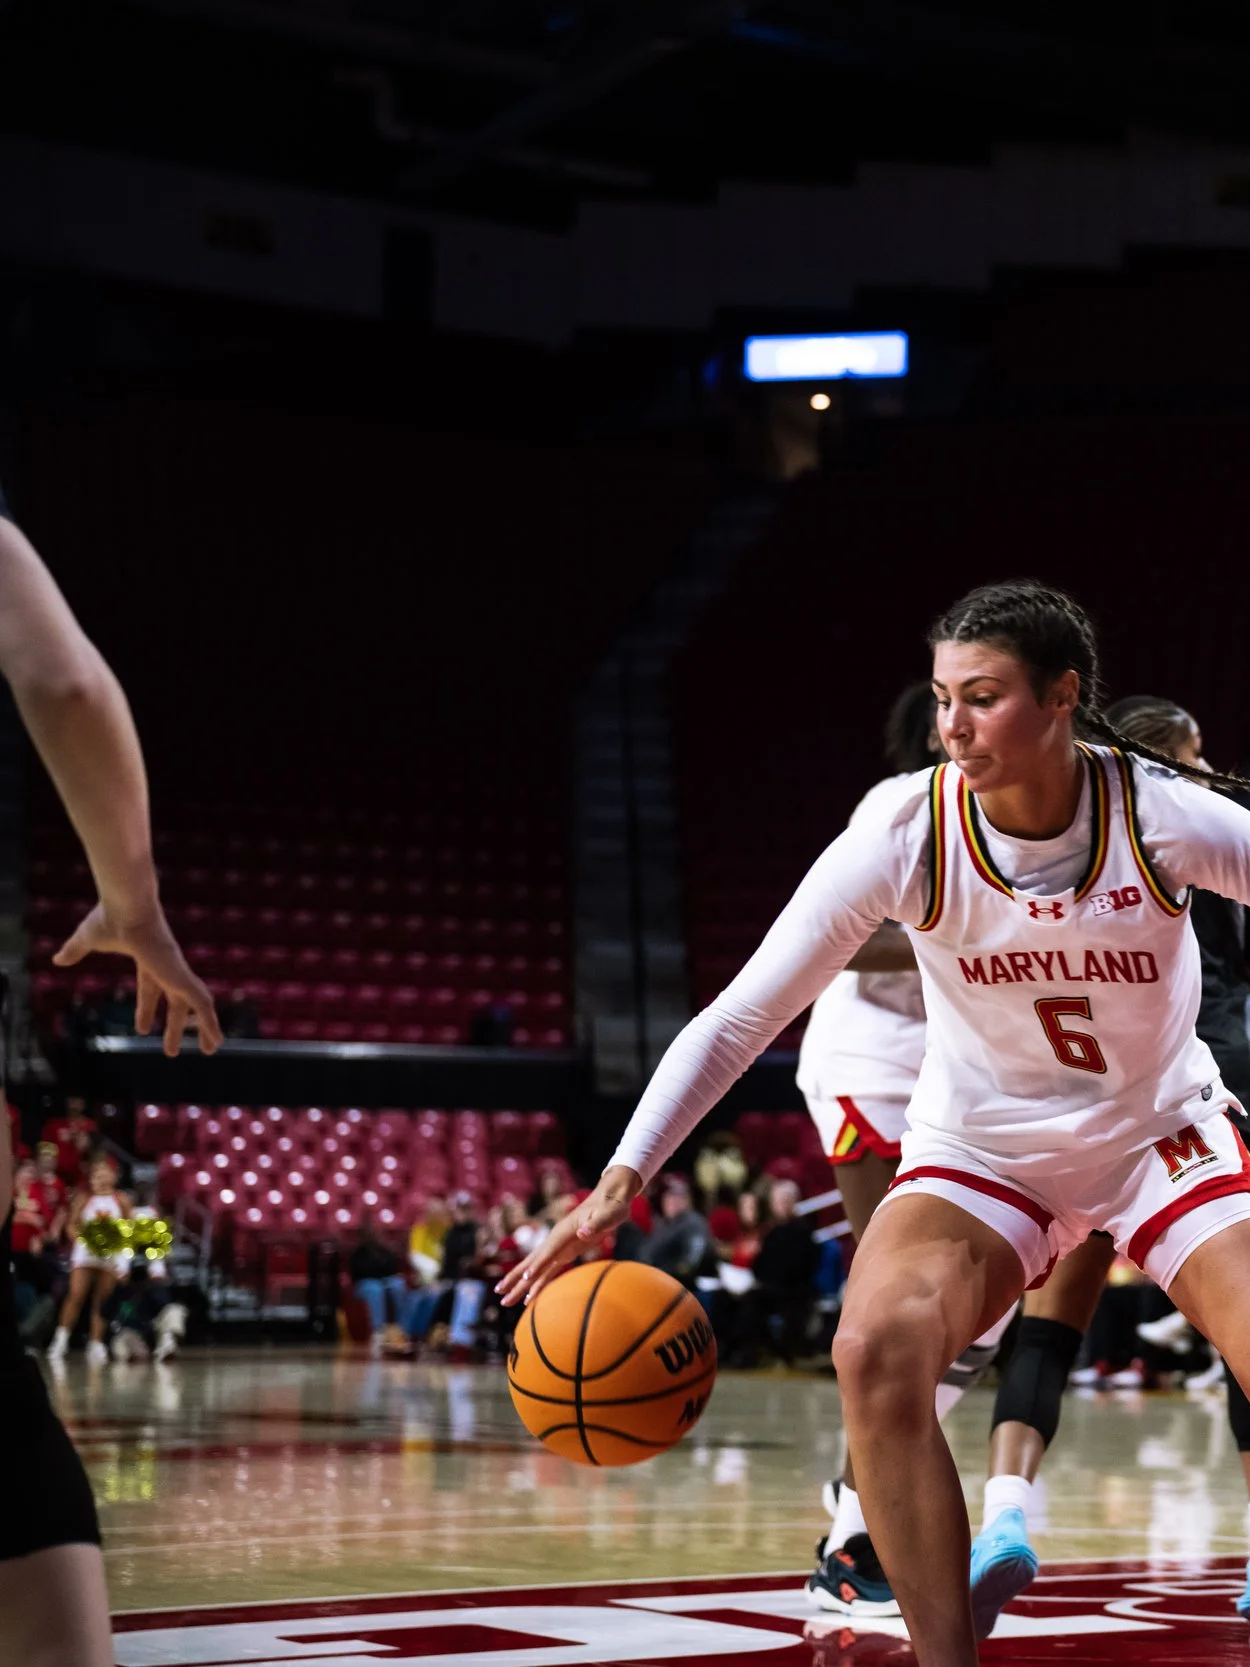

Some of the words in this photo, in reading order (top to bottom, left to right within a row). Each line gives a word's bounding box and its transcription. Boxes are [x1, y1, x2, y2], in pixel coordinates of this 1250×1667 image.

[958, 950, 1159, 985] MARYLAND
[1034, 997, 1107, 1074] 6
[1152, 1124, 1215, 1177] M
